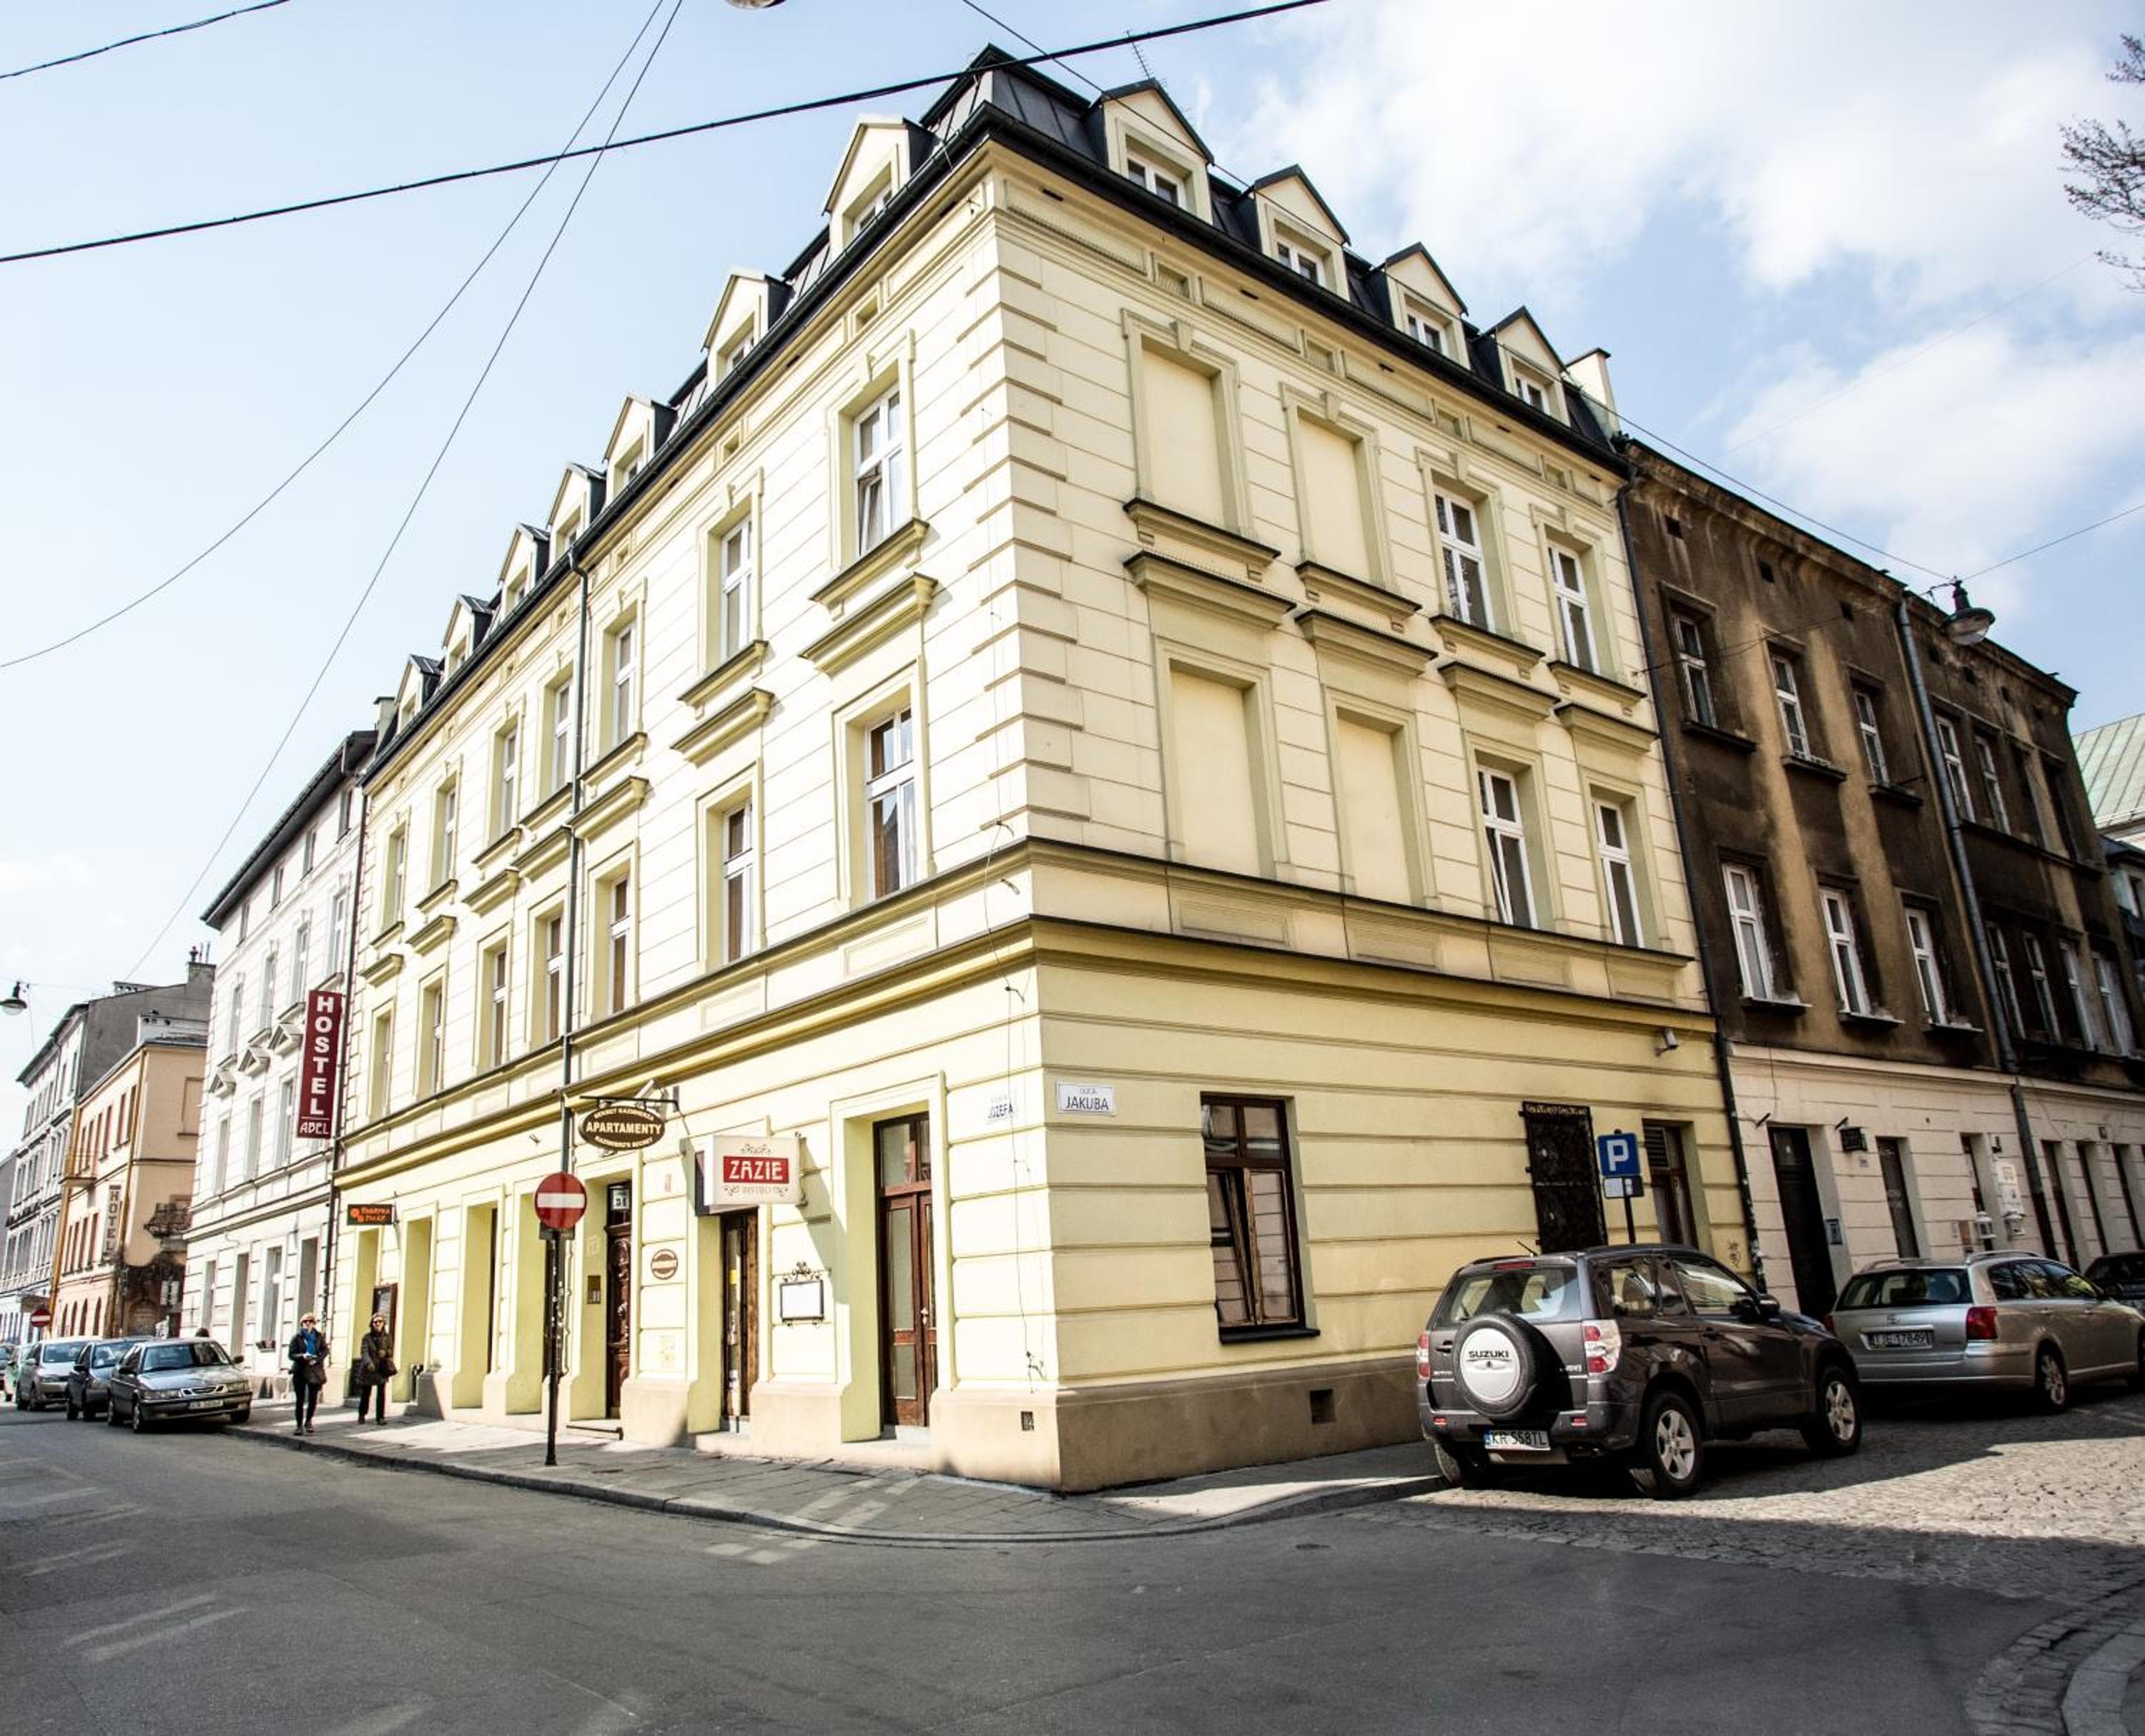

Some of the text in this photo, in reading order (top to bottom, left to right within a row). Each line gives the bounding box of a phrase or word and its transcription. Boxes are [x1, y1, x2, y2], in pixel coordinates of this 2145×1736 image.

[310, 996, 334, 1115] HOSTEL
[1066, 1096, 1109, 1110] JAKUBA
[586, 1121, 662, 1134] APARTAMENTY
[1607, 1139, 1629, 1172] P
[729, 1160, 783, 1180] ZAZIE
[106, 1190, 119, 1251] HOTEL
[1469, 1350, 1509, 1358] SUZUKI
